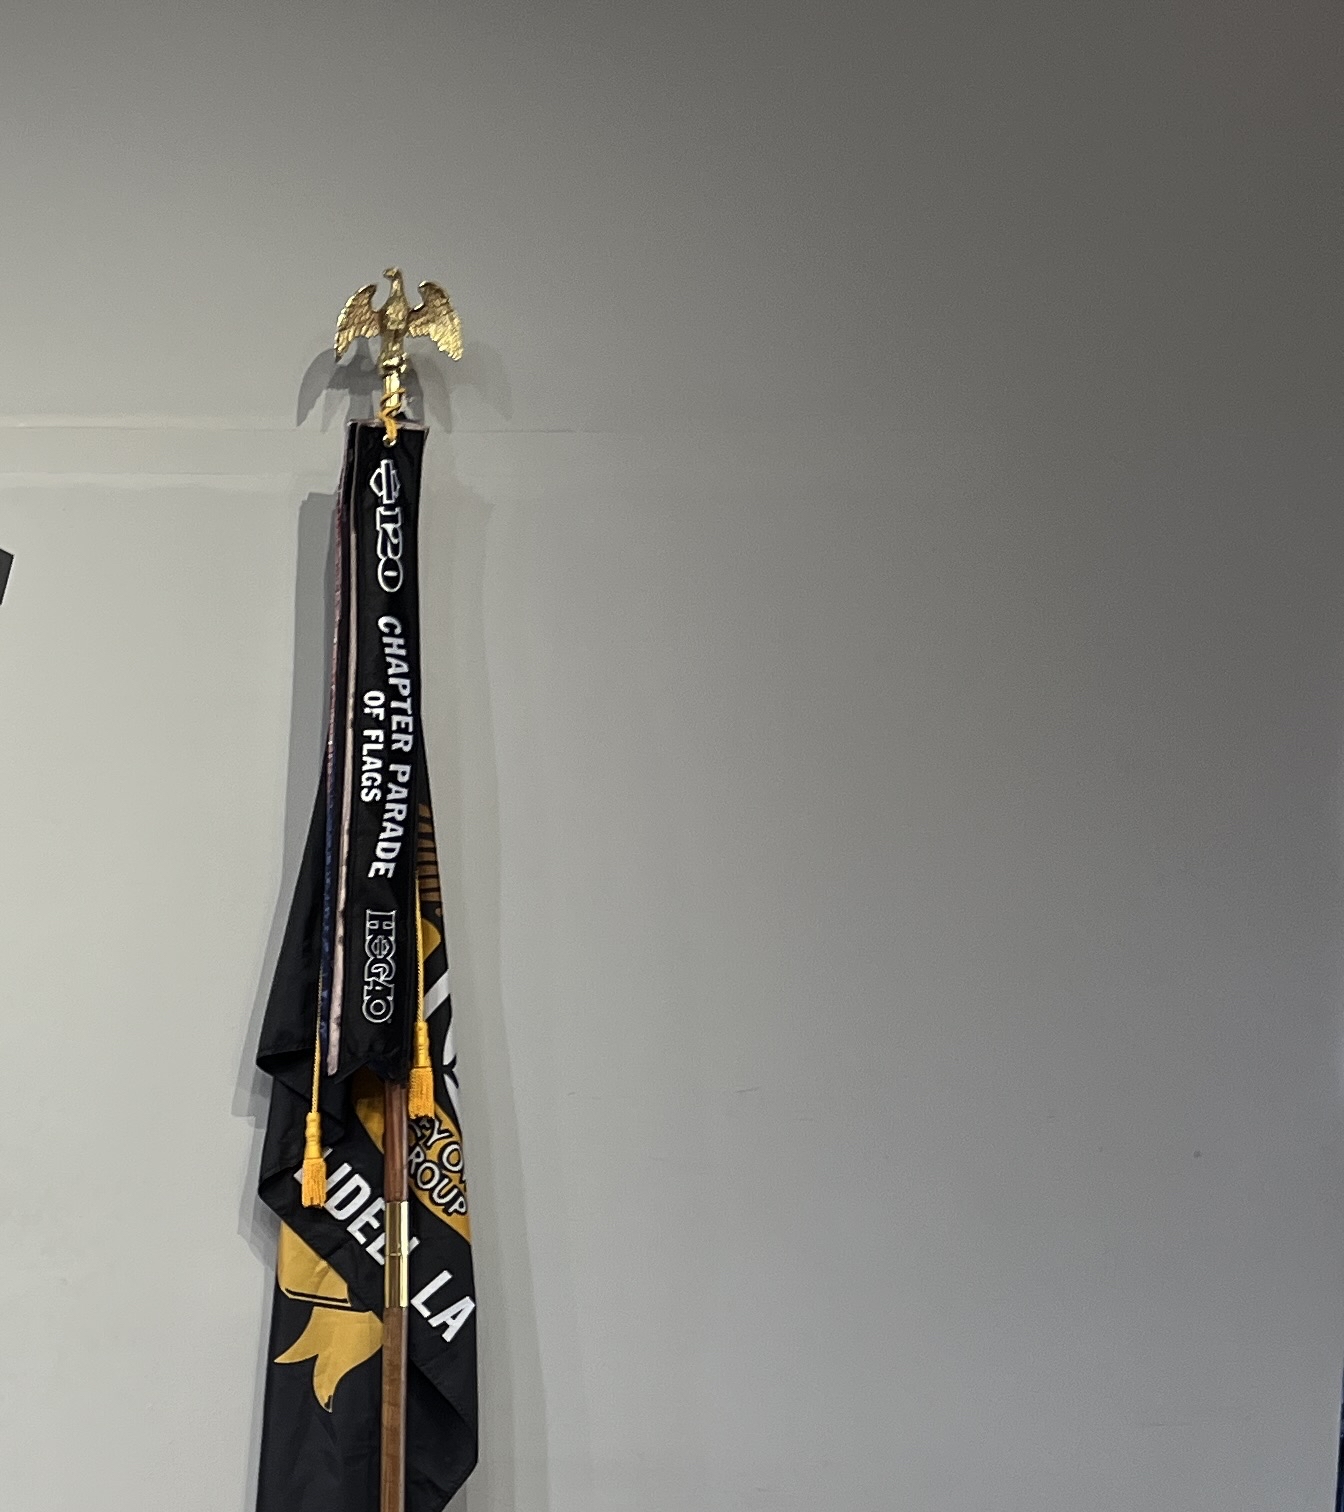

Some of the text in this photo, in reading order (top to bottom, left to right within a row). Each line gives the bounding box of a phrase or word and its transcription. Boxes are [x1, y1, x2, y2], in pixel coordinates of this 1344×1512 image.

[360, 690, 386, 802] OF FLAGS
[367, 615, 414, 879] CHAPTER PARADE
[410, 1269, 476, 1343] LA
